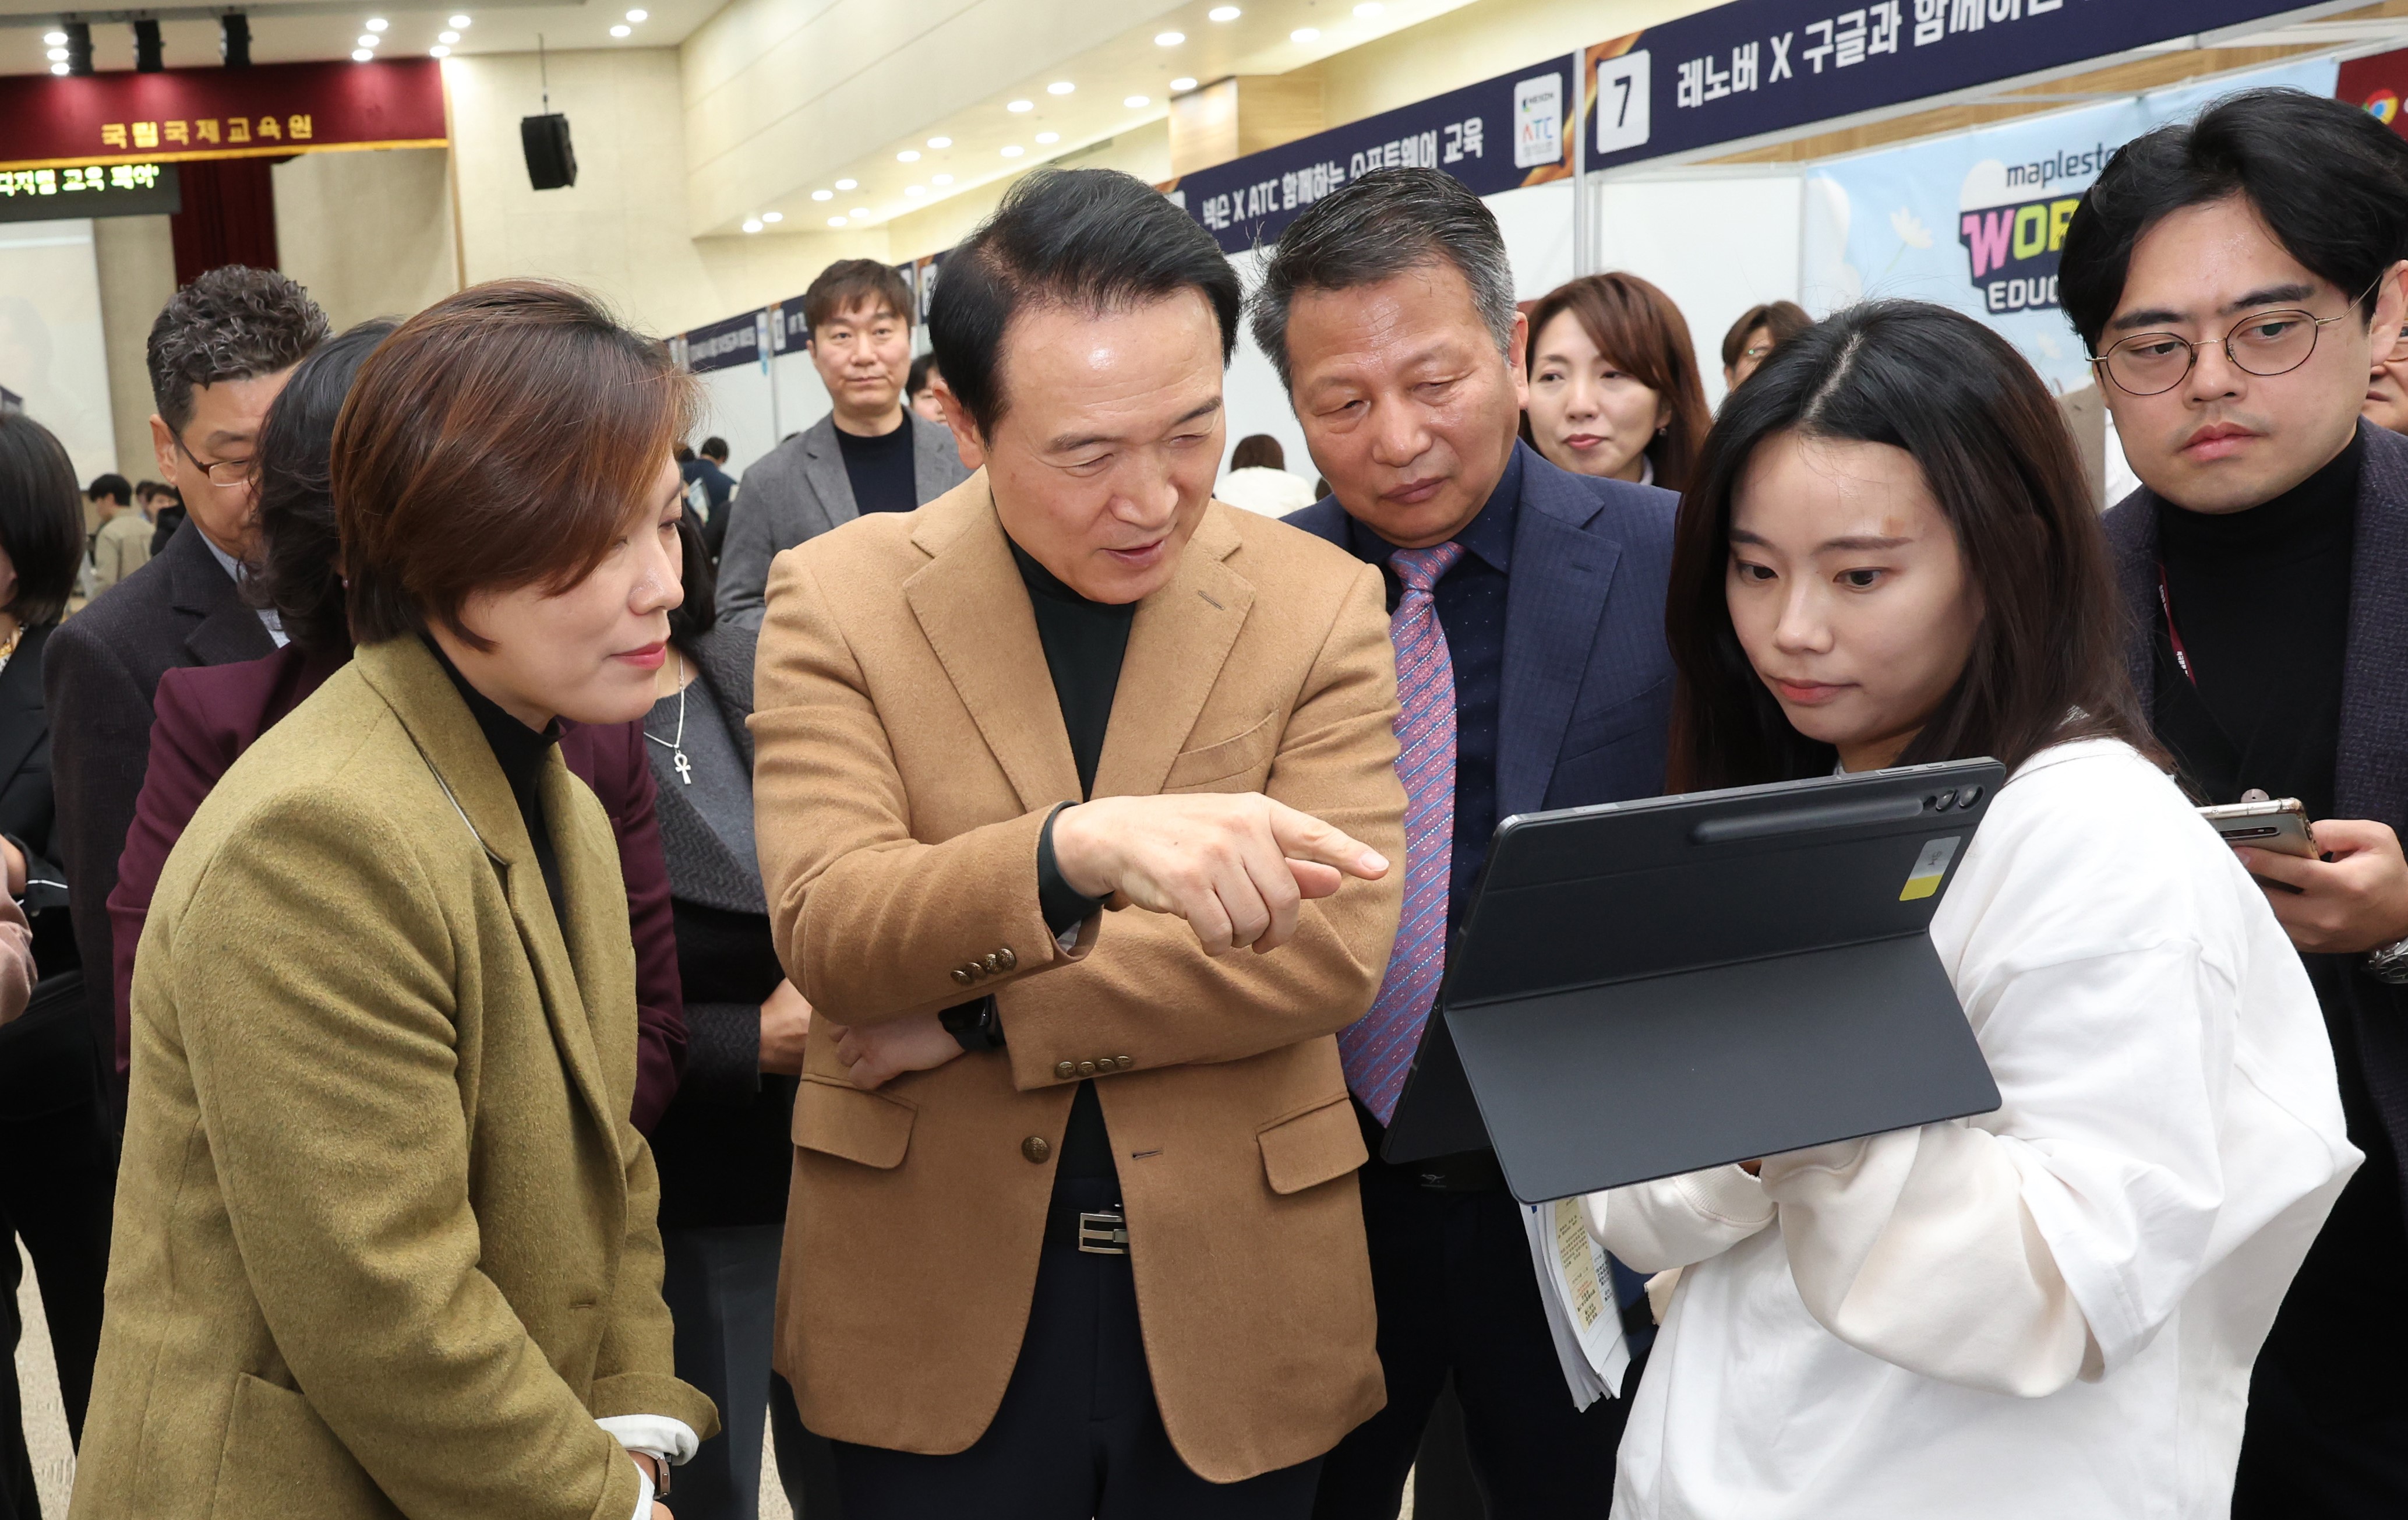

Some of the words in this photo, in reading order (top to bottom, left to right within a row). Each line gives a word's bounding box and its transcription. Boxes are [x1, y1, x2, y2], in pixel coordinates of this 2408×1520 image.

[1677, 40, 1759, 108] 레노버
[1769, 31, 1793, 83] X
[1803, 1, 1902, 73] 구글과
[1614, 75, 1632, 128] 7
[101, 114, 312, 149] 국립국제교육원
[62, 166, 105, 191] 교육
[1203, 194, 1230, 231] 넥슨
[1232, 189, 1245, 223] X
[1248, 178, 1280, 218] ATC
[1443, 117, 1484, 164] 교육
